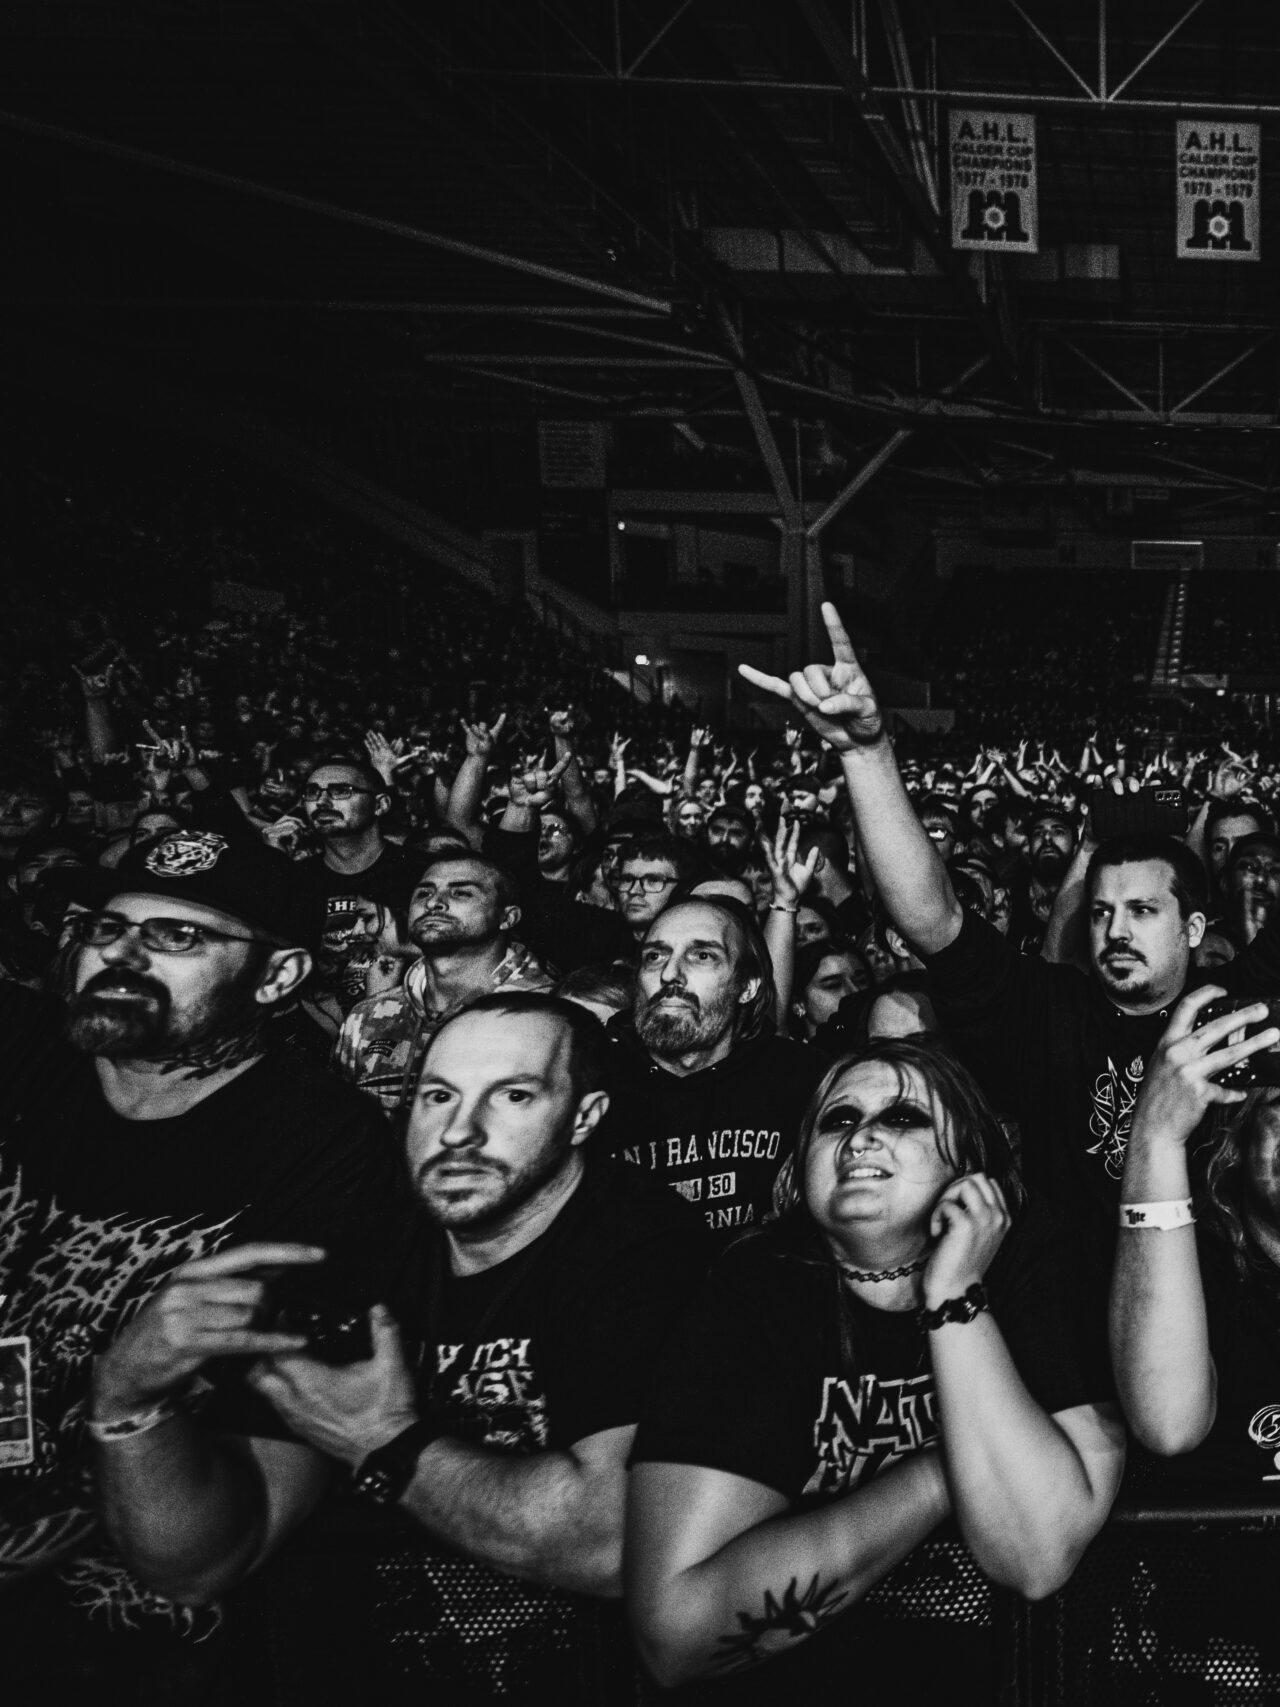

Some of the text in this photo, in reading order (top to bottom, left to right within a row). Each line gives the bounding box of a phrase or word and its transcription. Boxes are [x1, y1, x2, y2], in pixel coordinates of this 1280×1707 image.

[958, 120, 1028, 143] A.H.L.
[1186, 131, 1253, 152] A.H.L.
[952, 143, 1033, 157] CALDER CUP
[953, 156, 1032, 172] CHAMPIONS
[1179, 154, 1258, 166] CALDER CUP
[1180, 166, 1256, 181] CHAMPIONS
